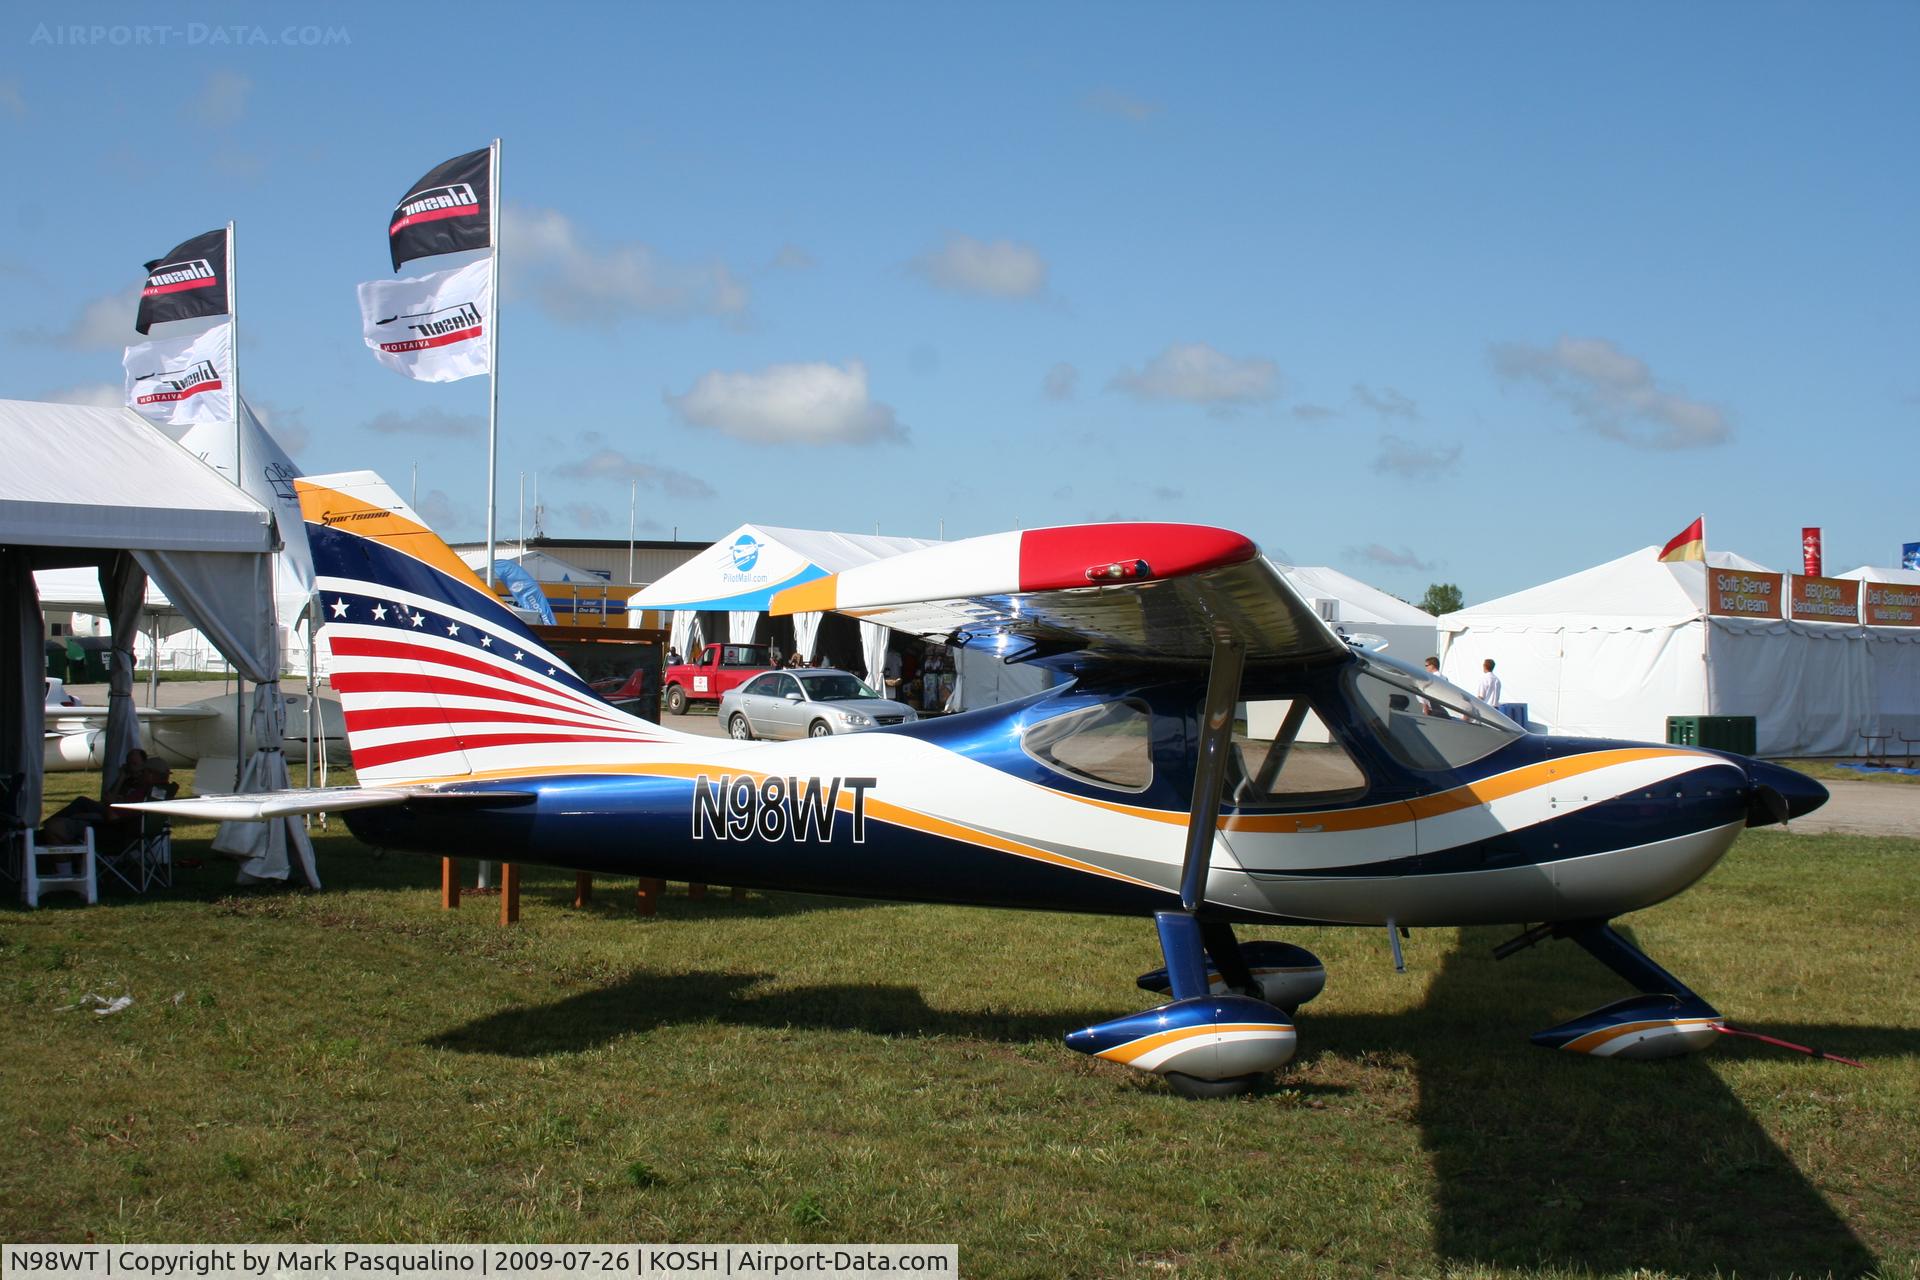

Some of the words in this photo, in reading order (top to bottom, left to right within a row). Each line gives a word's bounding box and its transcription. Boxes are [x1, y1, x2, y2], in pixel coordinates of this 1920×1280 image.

[321, 511, 391, 526] Sportsman
[723, 573, 768, 584] PilotMall.com
[1717, 573, 1740, 592] Soft
[1742, 576, 1771, 594] Serve
[1805, 583, 1823, 601] BBQ
[1823, 584, 1842, 599] Pork
[1719, 595, 1736, 611] Ice
[1736, 596, 1768, 612] Cream
[1792, 598, 1828, 615] Sandwich
[1829, 602, 1857, 617] Basket
[692, 774, 877, 844] N98WT
